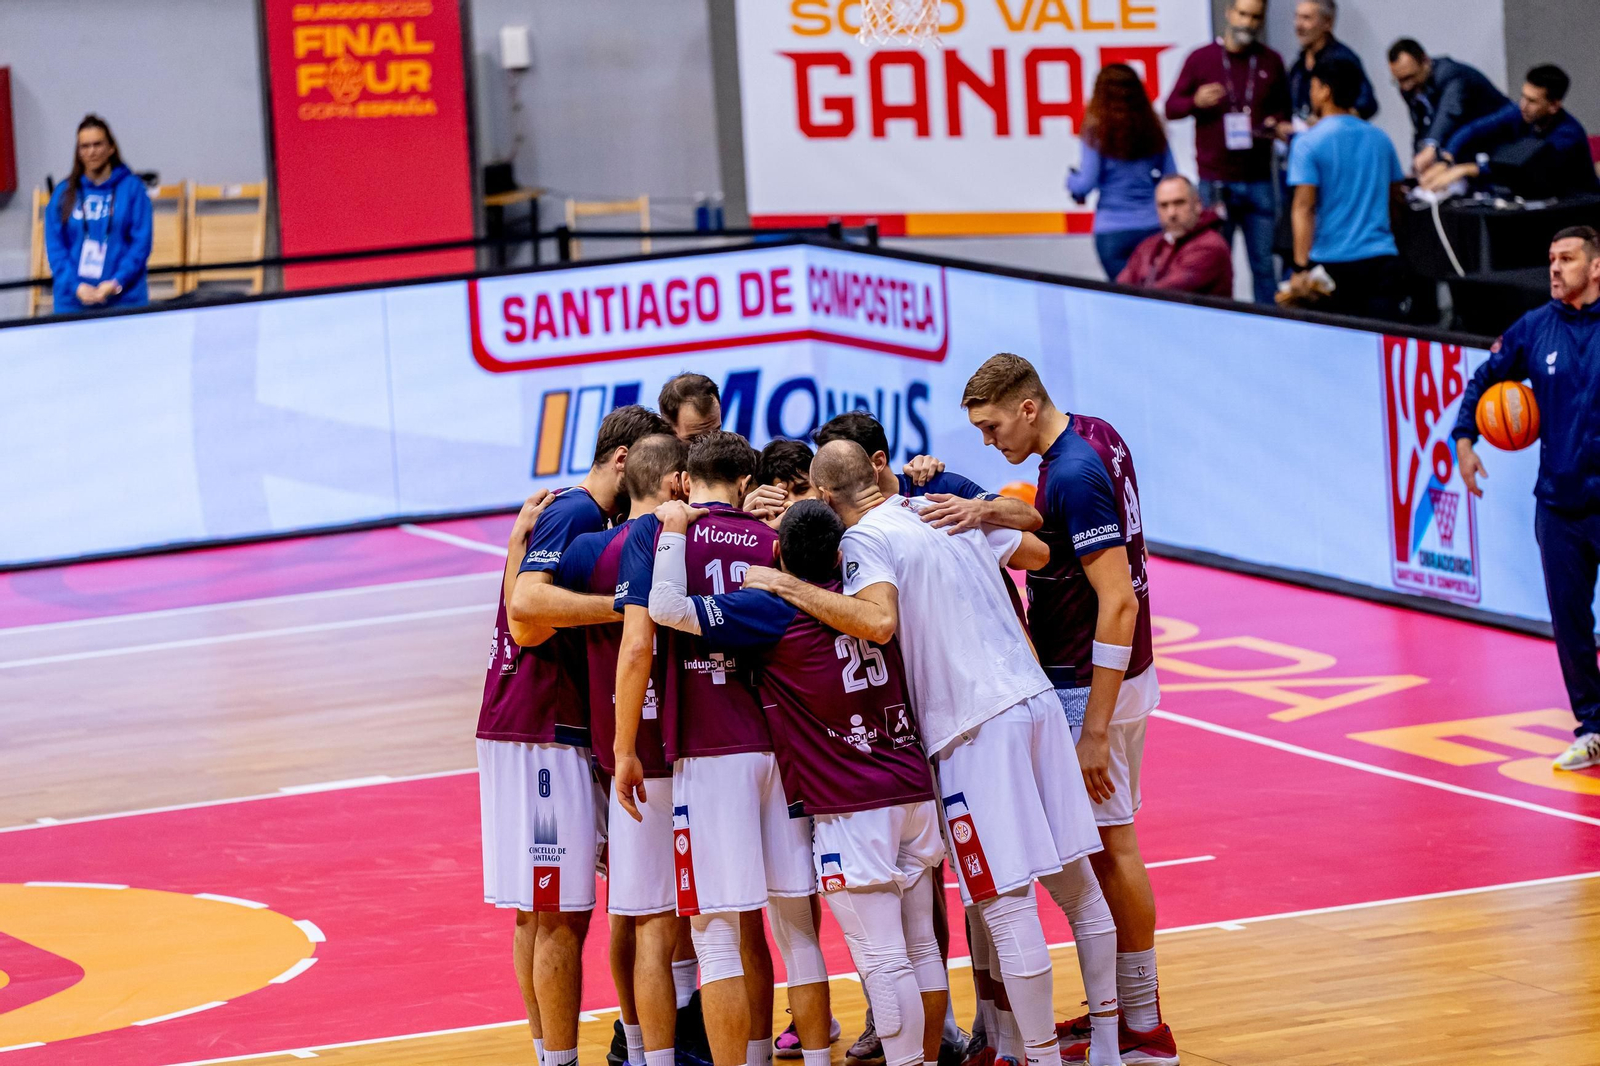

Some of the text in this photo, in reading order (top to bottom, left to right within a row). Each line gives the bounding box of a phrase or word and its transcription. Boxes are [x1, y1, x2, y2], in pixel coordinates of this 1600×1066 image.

[1000, 0, 1158, 32] VALE
[294, 22, 435, 59] FINAL
[502, 265, 937, 344] SANTIAGO DE COMPOSTELA
[694, 524, 759, 547] Micovic
[1072, 523, 1119, 544] OBRADOIRO
[684, 657, 736, 671] indupanel
[834, 634, 889, 694] 25
[538, 768, 551, 798] 8
[558, 847, 567, 855] DE
